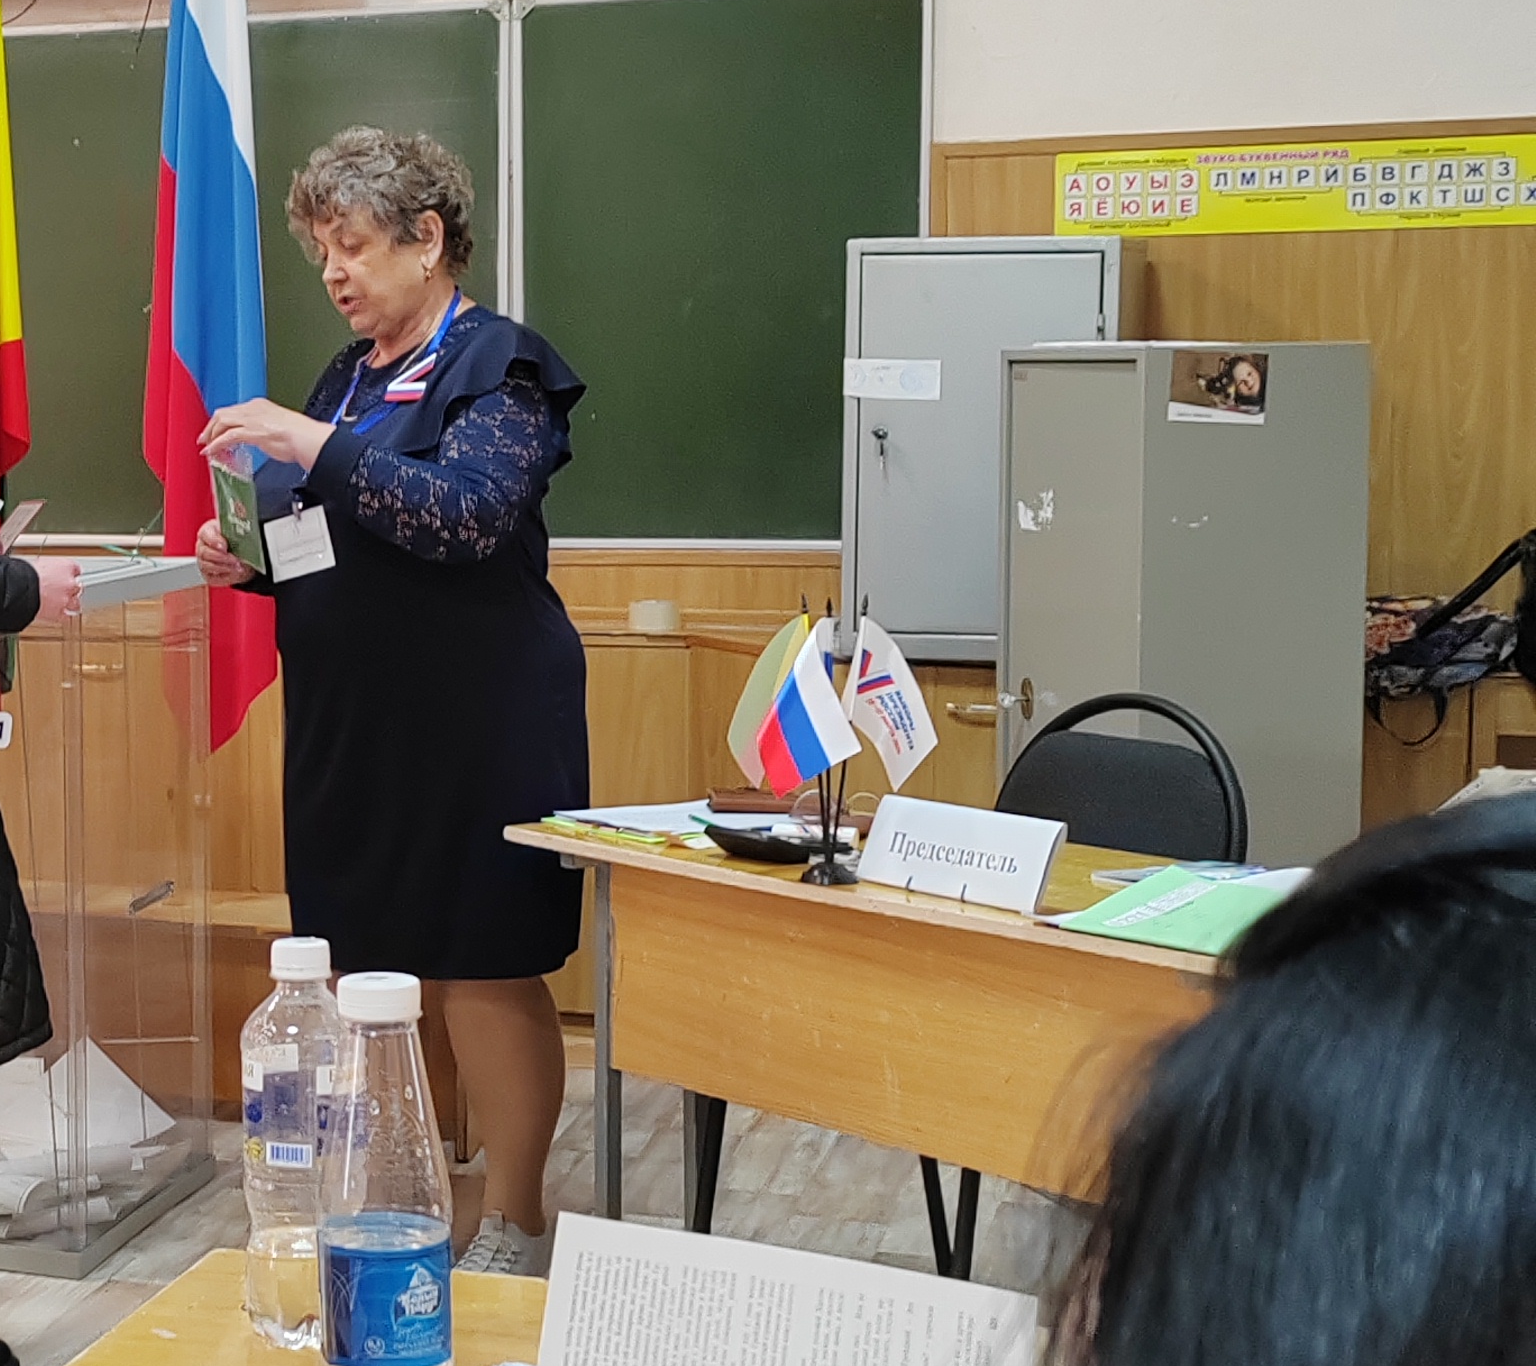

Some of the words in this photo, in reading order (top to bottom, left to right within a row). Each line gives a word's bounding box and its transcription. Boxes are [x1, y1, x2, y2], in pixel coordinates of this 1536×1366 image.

[1214, 172, 1229, 188] Л
[1240, 172, 1257, 186] М
[1269, 171, 1282, 185] Н
[1297, 170, 1310, 184] Р
[1325, 164, 1339, 183] Й
[1353, 167, 1367, 182] Б
[1381, 166, 1395, 181] В
[1410, 165, 1422, 179] Г
[1437, 163, 1453, 180] Д
[1465, 162, 1484, 178] Ж
[1498, 161, 1510, 177] З
[1068, 178, 1082, 192] А
[1095, 176, 1112, 191] О
[1125, 175, 1137, 191] У
[1150, 174, 1168, 190] Ы
[1181, 173, 1194, 188] Э
[1068, 202, 1082, 217] Я
[1097, 197, 1108, 216] Ё
[1121, 201, 1141, 215] Ю
[1152, 200, 1166, 214] И
[1180, 198, 1192, 213] Е
[1352, 192, 1365, 207] П
[1379, 192, 1396, 206] Ф
[1410, 191, 1421, 205] К
[1440, 189, 1451, 203] Т
[1464, 188, 1484, 203] Ш
[1496, 187, 1510, 202] С
[889, 830, 1018, 874] Председатель
